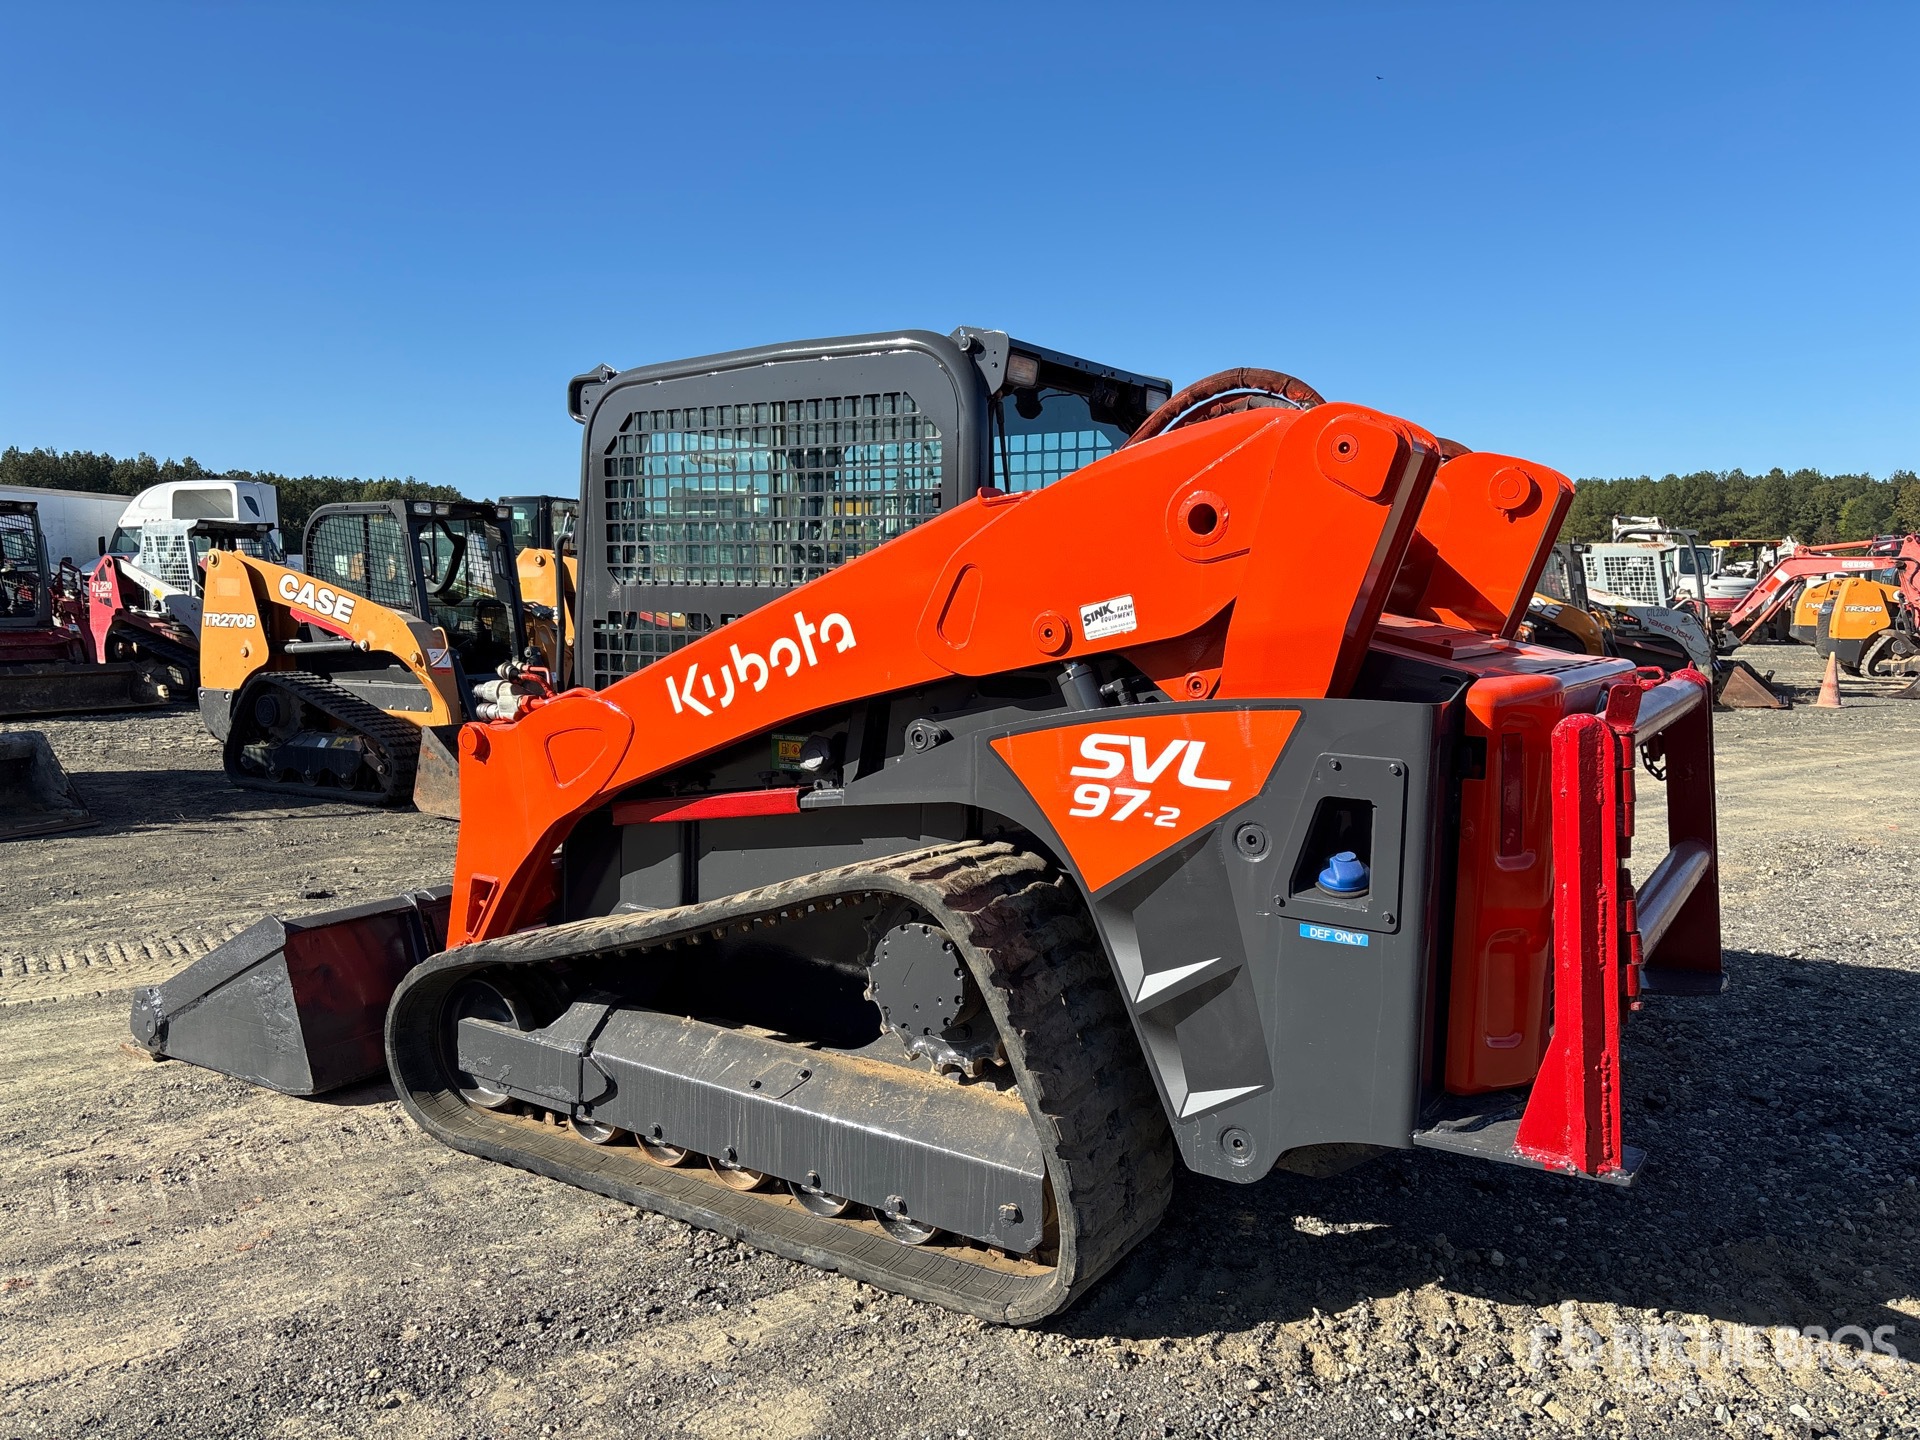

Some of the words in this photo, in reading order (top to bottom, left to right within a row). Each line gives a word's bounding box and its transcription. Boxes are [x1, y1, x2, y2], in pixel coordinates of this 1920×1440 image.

[278, 573, 356, 624] CASE
[1844, 605, 1883, 613] TR310B
[204, 612, 256, 629] TR270B
[1083, 602, 1115, 627] SINK
[1116, 603, 1133, 612] FARM
[1101, 610, 1133, 623] EQUIPMENT
[665, 611, 857, 717] Kubota
[1069, 733, 1232, 791] SVL
[1069, 783, 1181, 828] 97-2
[1309, 927, 1331, 939] DEF
[1334, 931, 1363, 945] ONLY
